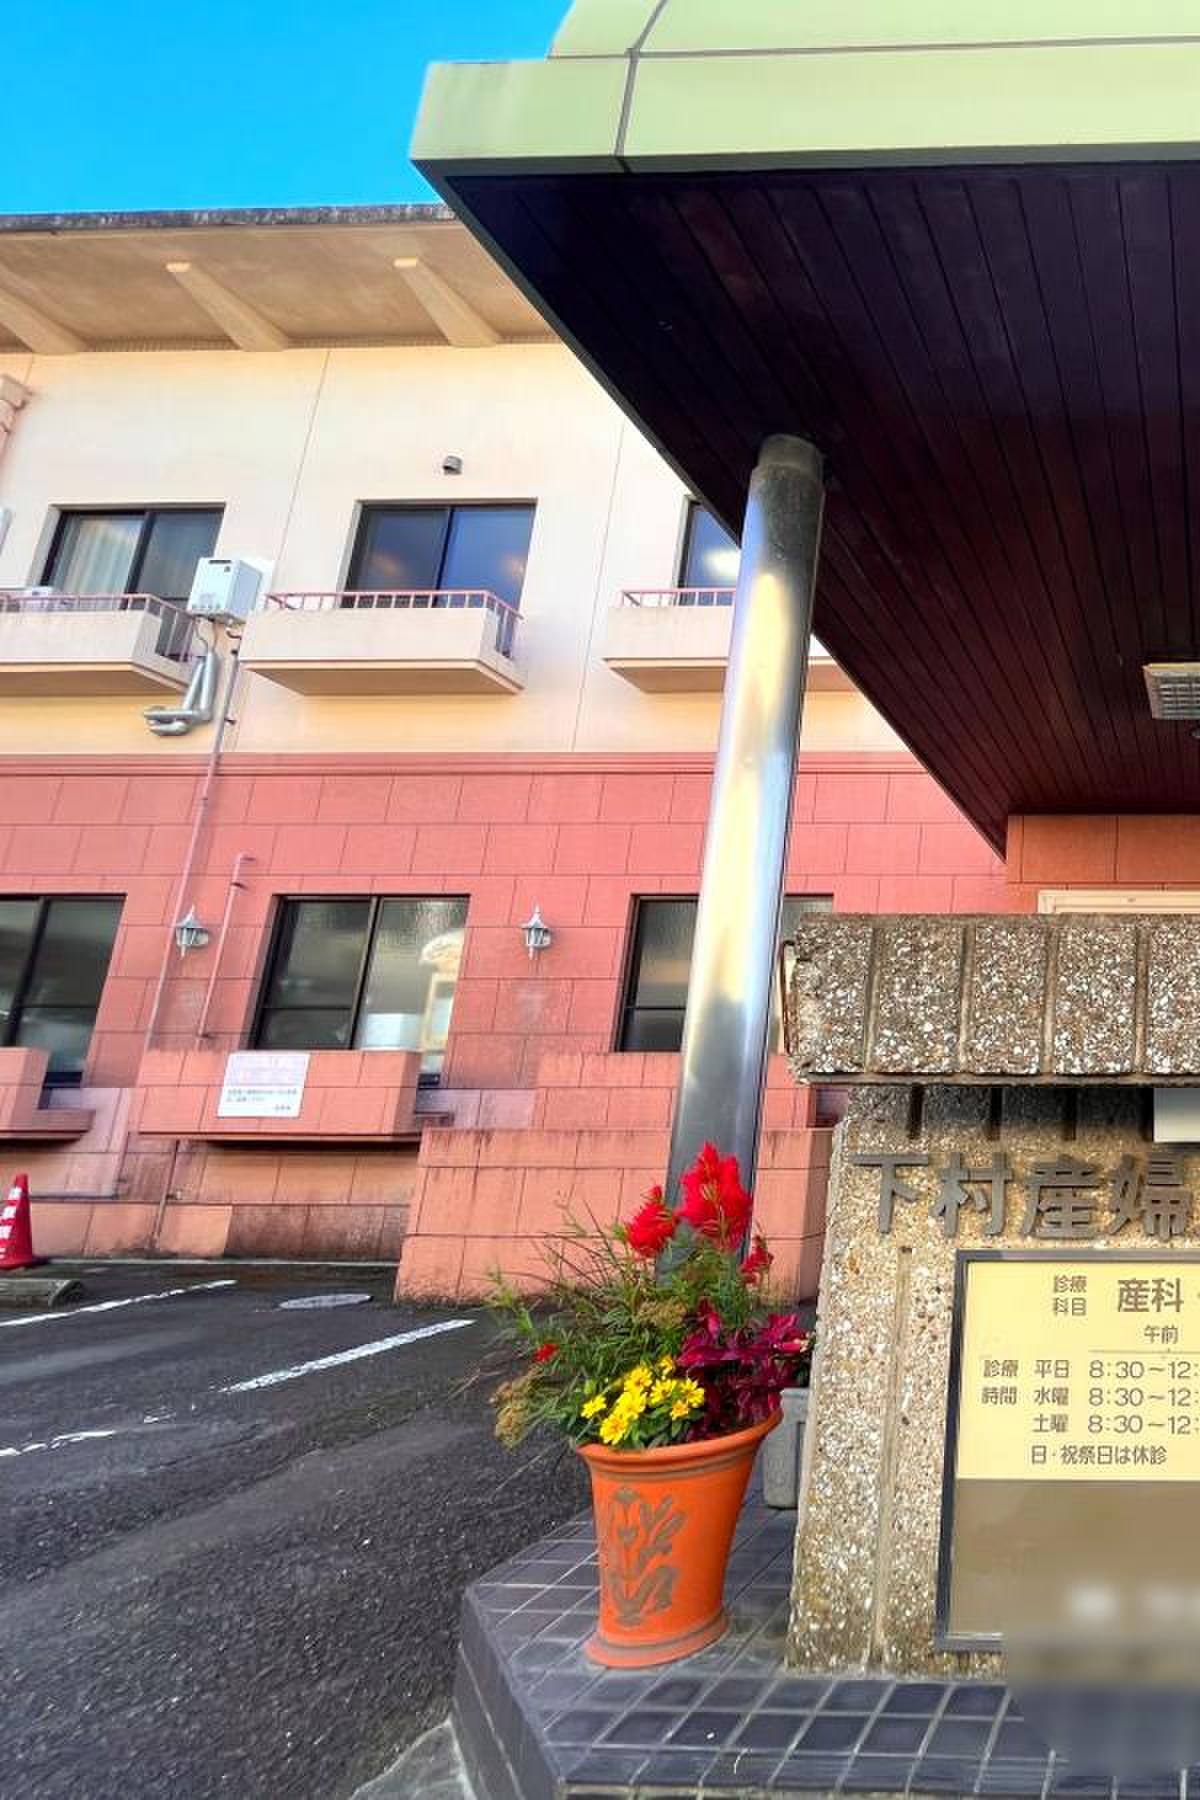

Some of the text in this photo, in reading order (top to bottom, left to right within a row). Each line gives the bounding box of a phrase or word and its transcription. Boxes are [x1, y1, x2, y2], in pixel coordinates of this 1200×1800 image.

[1053, 1275, 1087, 1293] 診療
[1053, 1297, 1087, 1316] 科目
[1144, 1325, 1178, 1344] 午前
[983, 1360, 1018, 1378] 診療
[1034, 1360, 1070, 1378] 平日
[981, 1387, 1017, 1406] 時間
[1034, 1387, 1069, 1406] 水曜
[1033, 1414, 1068, 1433] 土曜
